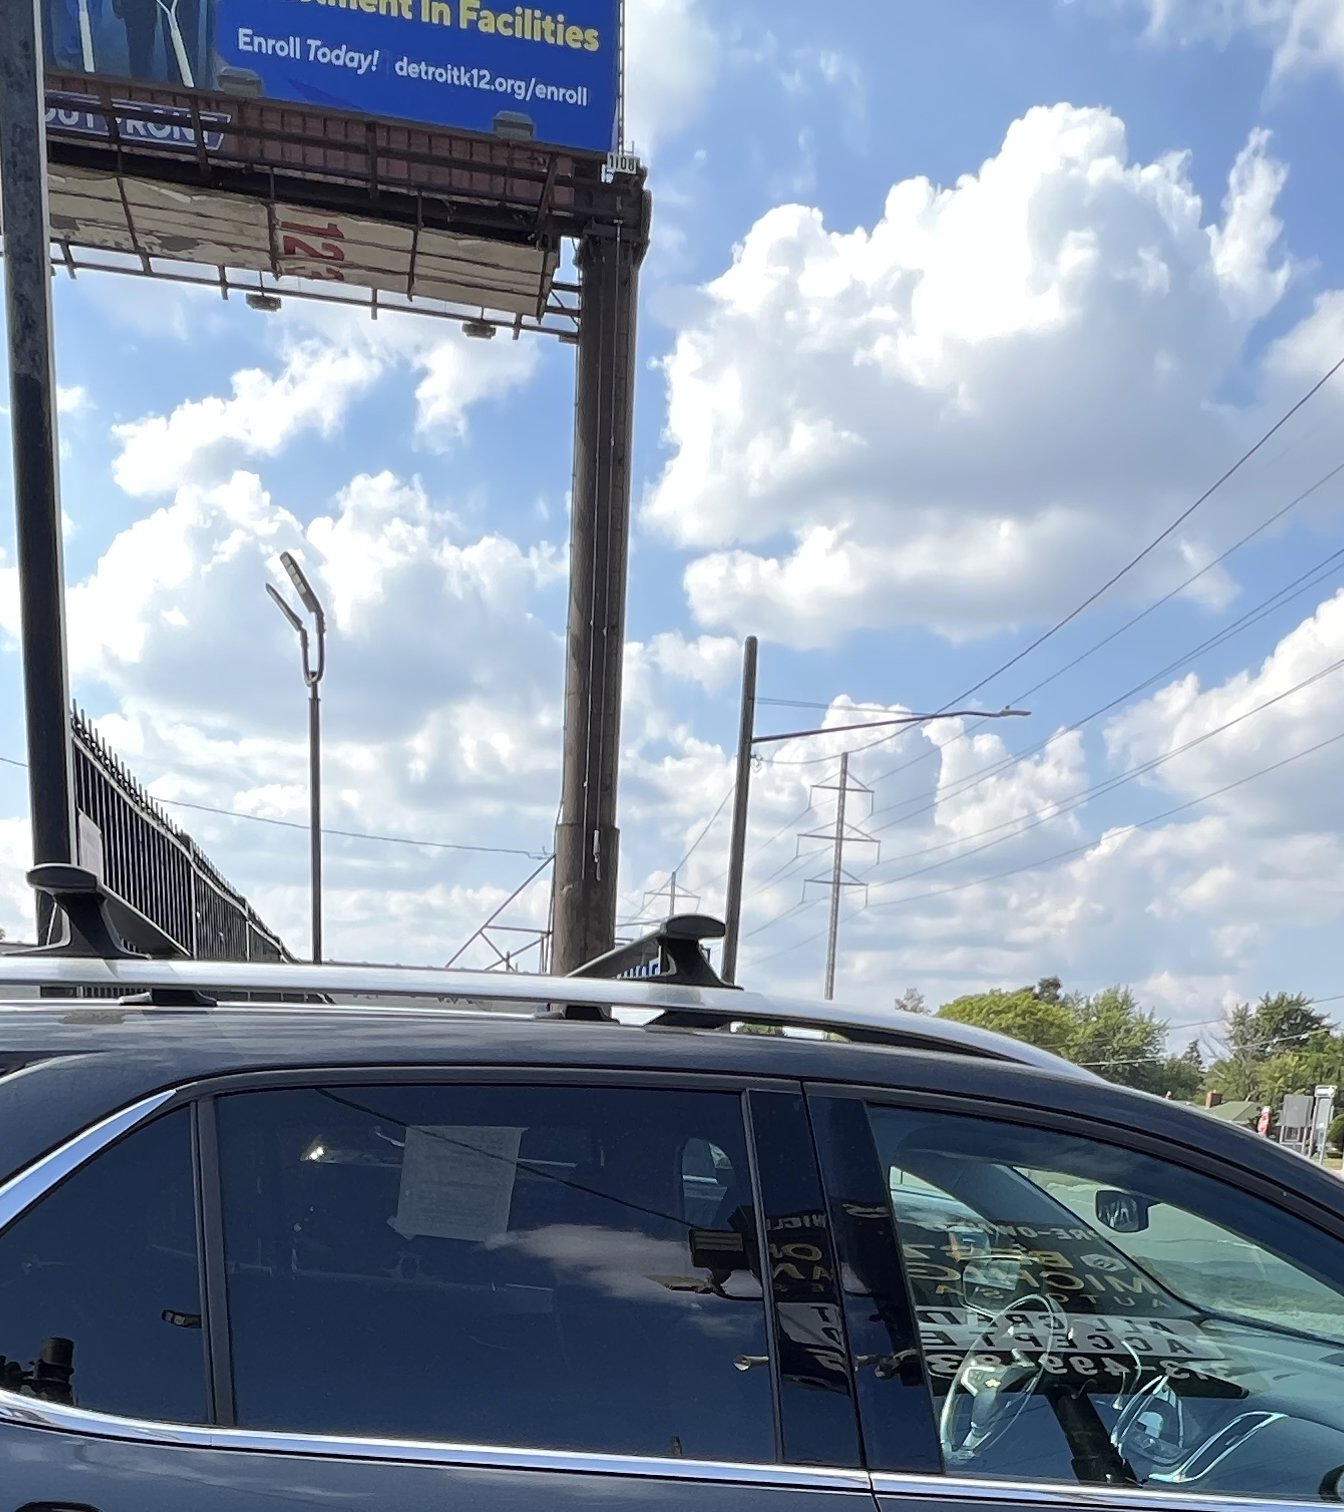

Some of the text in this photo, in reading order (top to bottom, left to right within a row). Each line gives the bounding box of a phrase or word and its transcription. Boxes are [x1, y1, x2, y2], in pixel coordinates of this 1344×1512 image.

[459, 0, 600, 52] Facilities
[236, 26, 589, 107] Enroll Today! detroitk12.org/enroll
